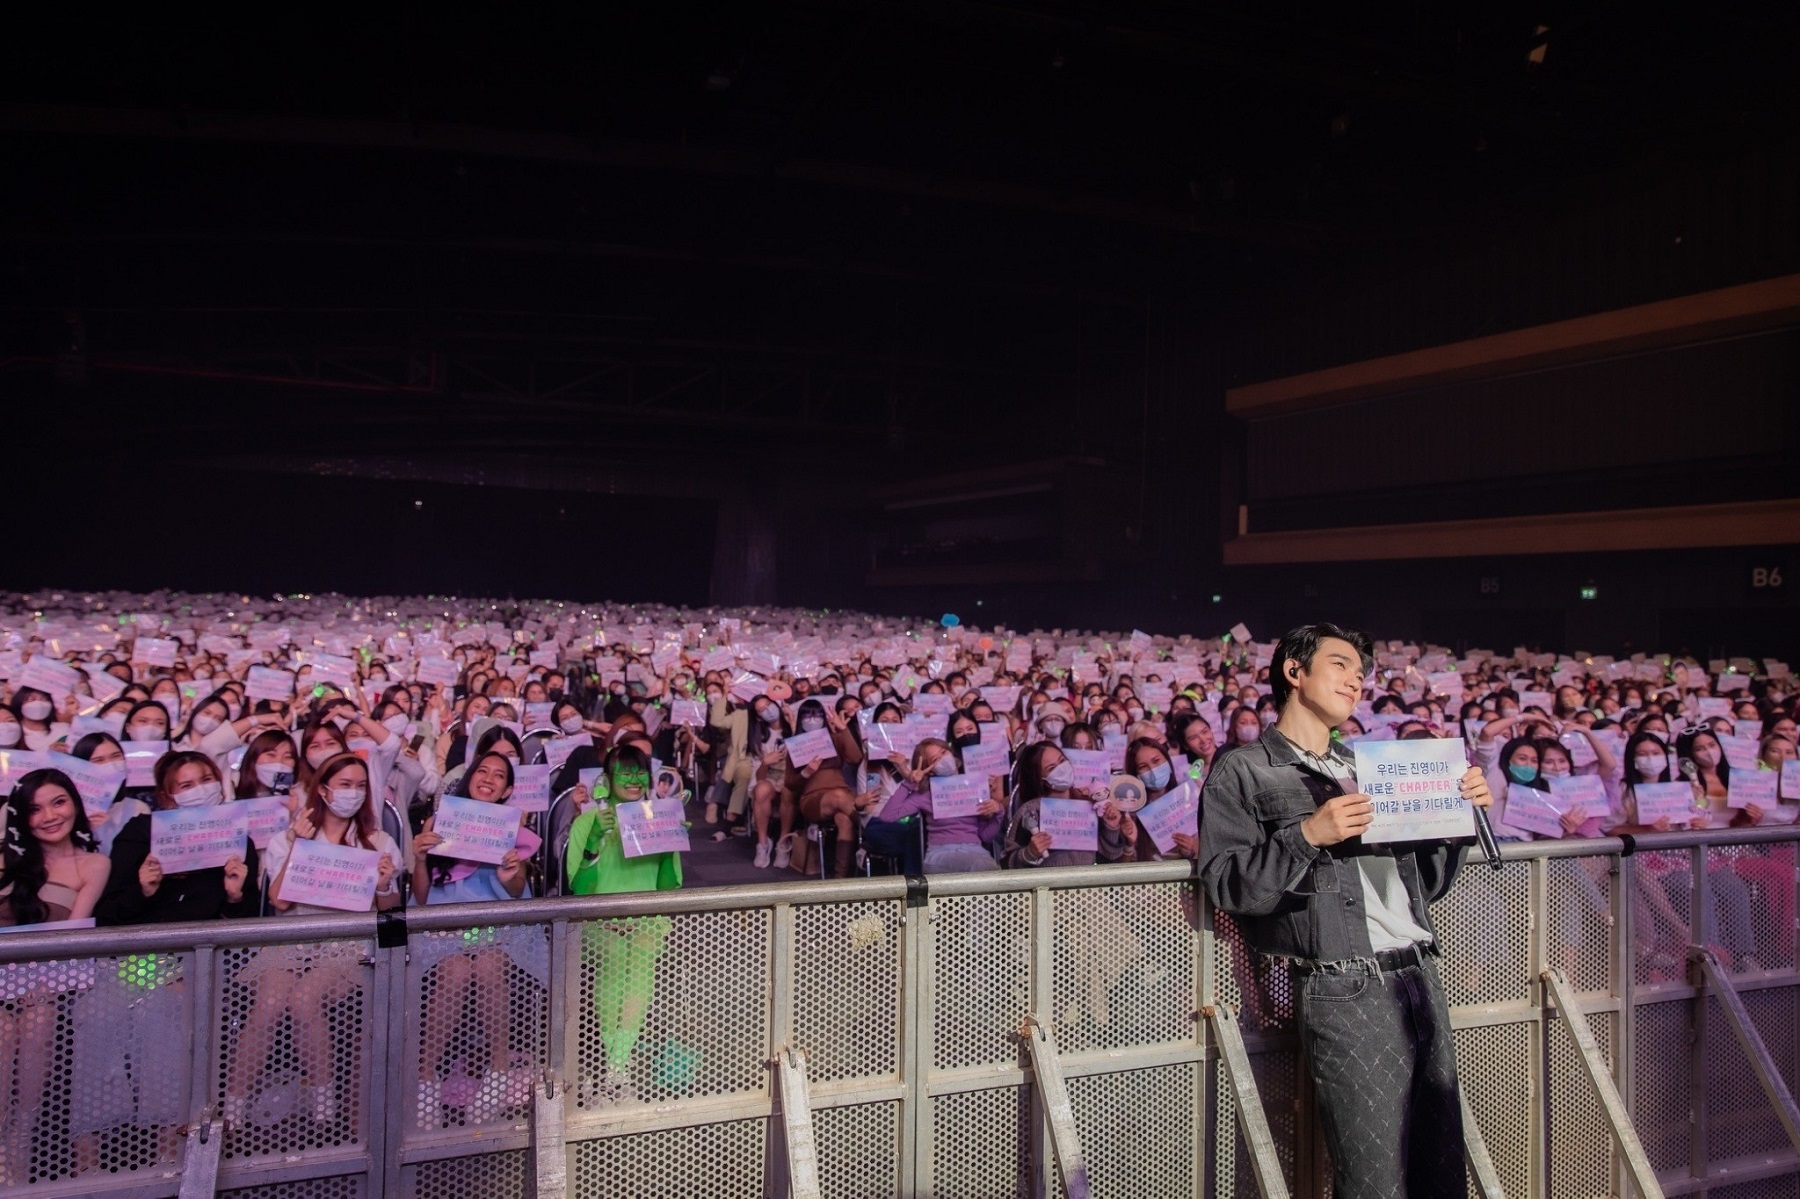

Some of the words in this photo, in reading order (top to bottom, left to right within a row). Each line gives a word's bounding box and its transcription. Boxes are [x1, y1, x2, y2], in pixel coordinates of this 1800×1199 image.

[1480, 576, 1500, 593] B5
[1753, 567, 1781, 587] B6
[1377, 763, 1407, 776] 우리는
[1410, 761, 1449, 775] 진영이가
[1364, 782, 1394, 795] 새로운
[1402, 799, 1421, 812] 날을
[1425, 797, 1463, 810] 기다릴게
